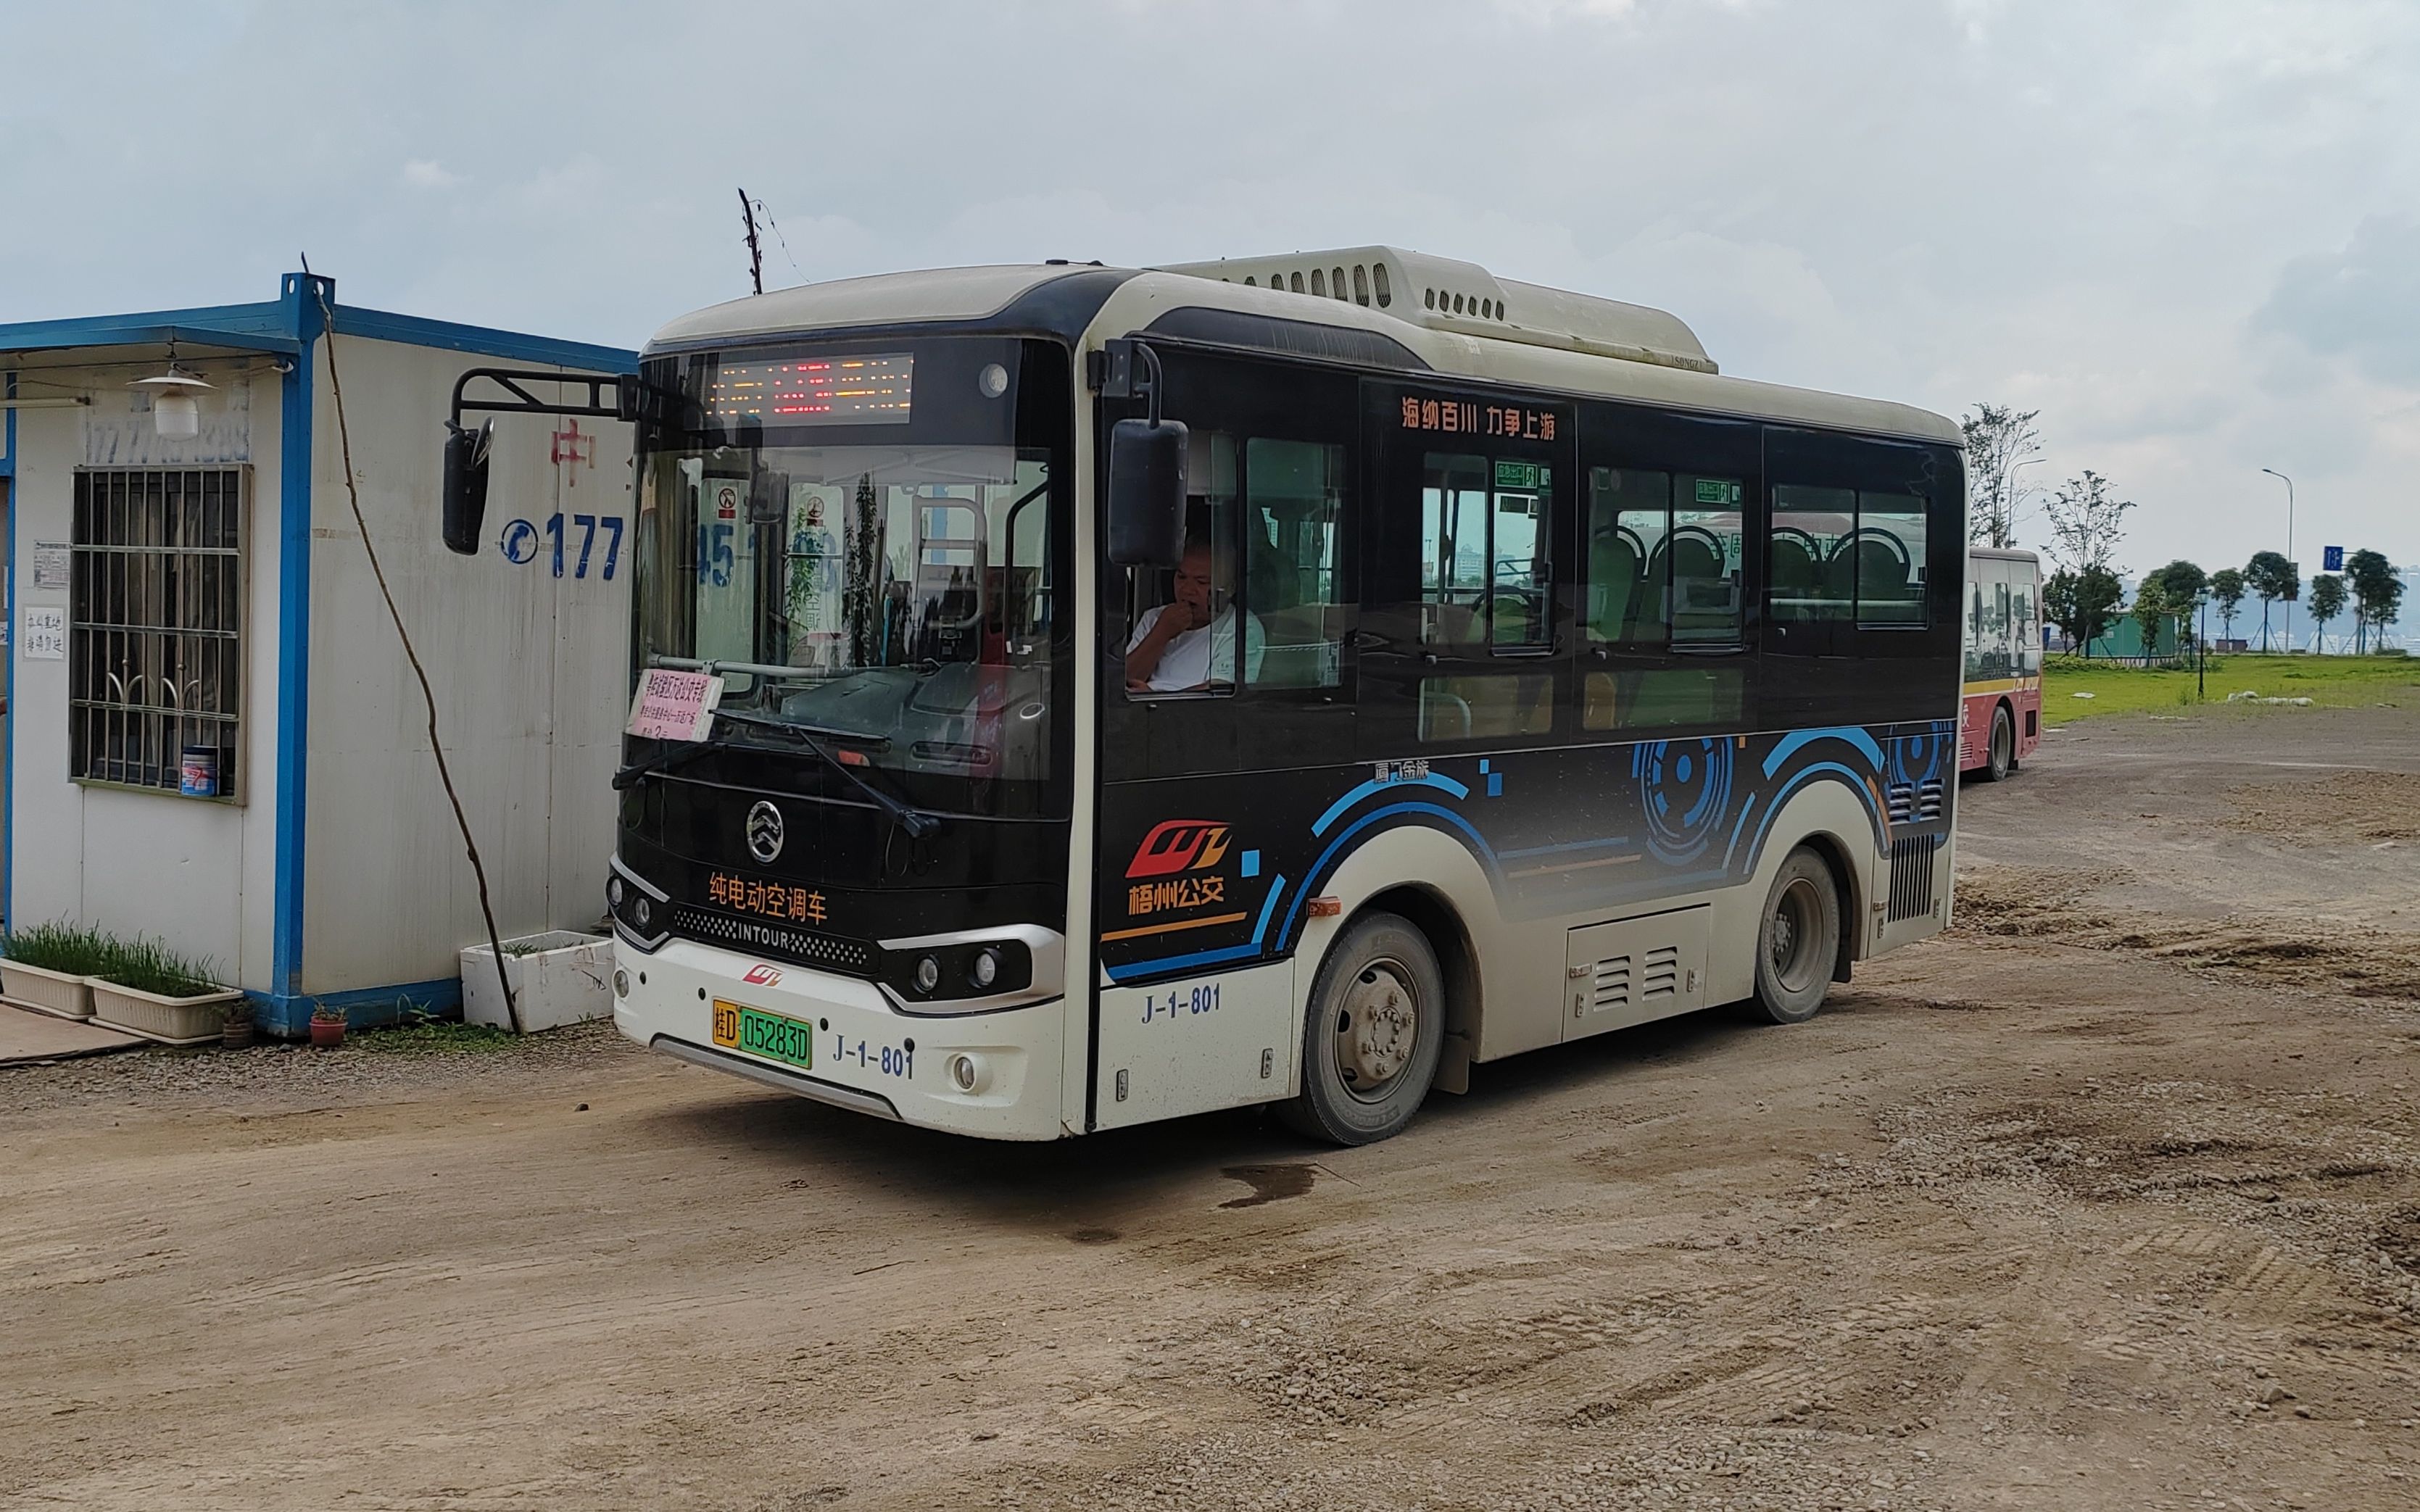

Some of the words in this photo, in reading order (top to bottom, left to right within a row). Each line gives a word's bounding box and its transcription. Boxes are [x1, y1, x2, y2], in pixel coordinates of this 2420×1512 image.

[1675, 355, 1700, 370] SONGZ
[1402, 396, 1478, 433] 海纳百川
[1487, 406, 1555, 441] 力争上游
[1498, 465, 1522, 478] 应急出口
[547, 512, 623, 581] 177
[1375, 760, 1430, 783] 厦门金旅
[709, 871, 828, 926] 纯电动空调车
[1129, 876, 1224, 915] 梧州公交
[738, 923, 789, 950] INTOUR
[1141, 982, 1219, 1024] J-1-801
[744, 1015, 808, 1060] 05283D
[832, 1034, 913, 1080] J-1-801
